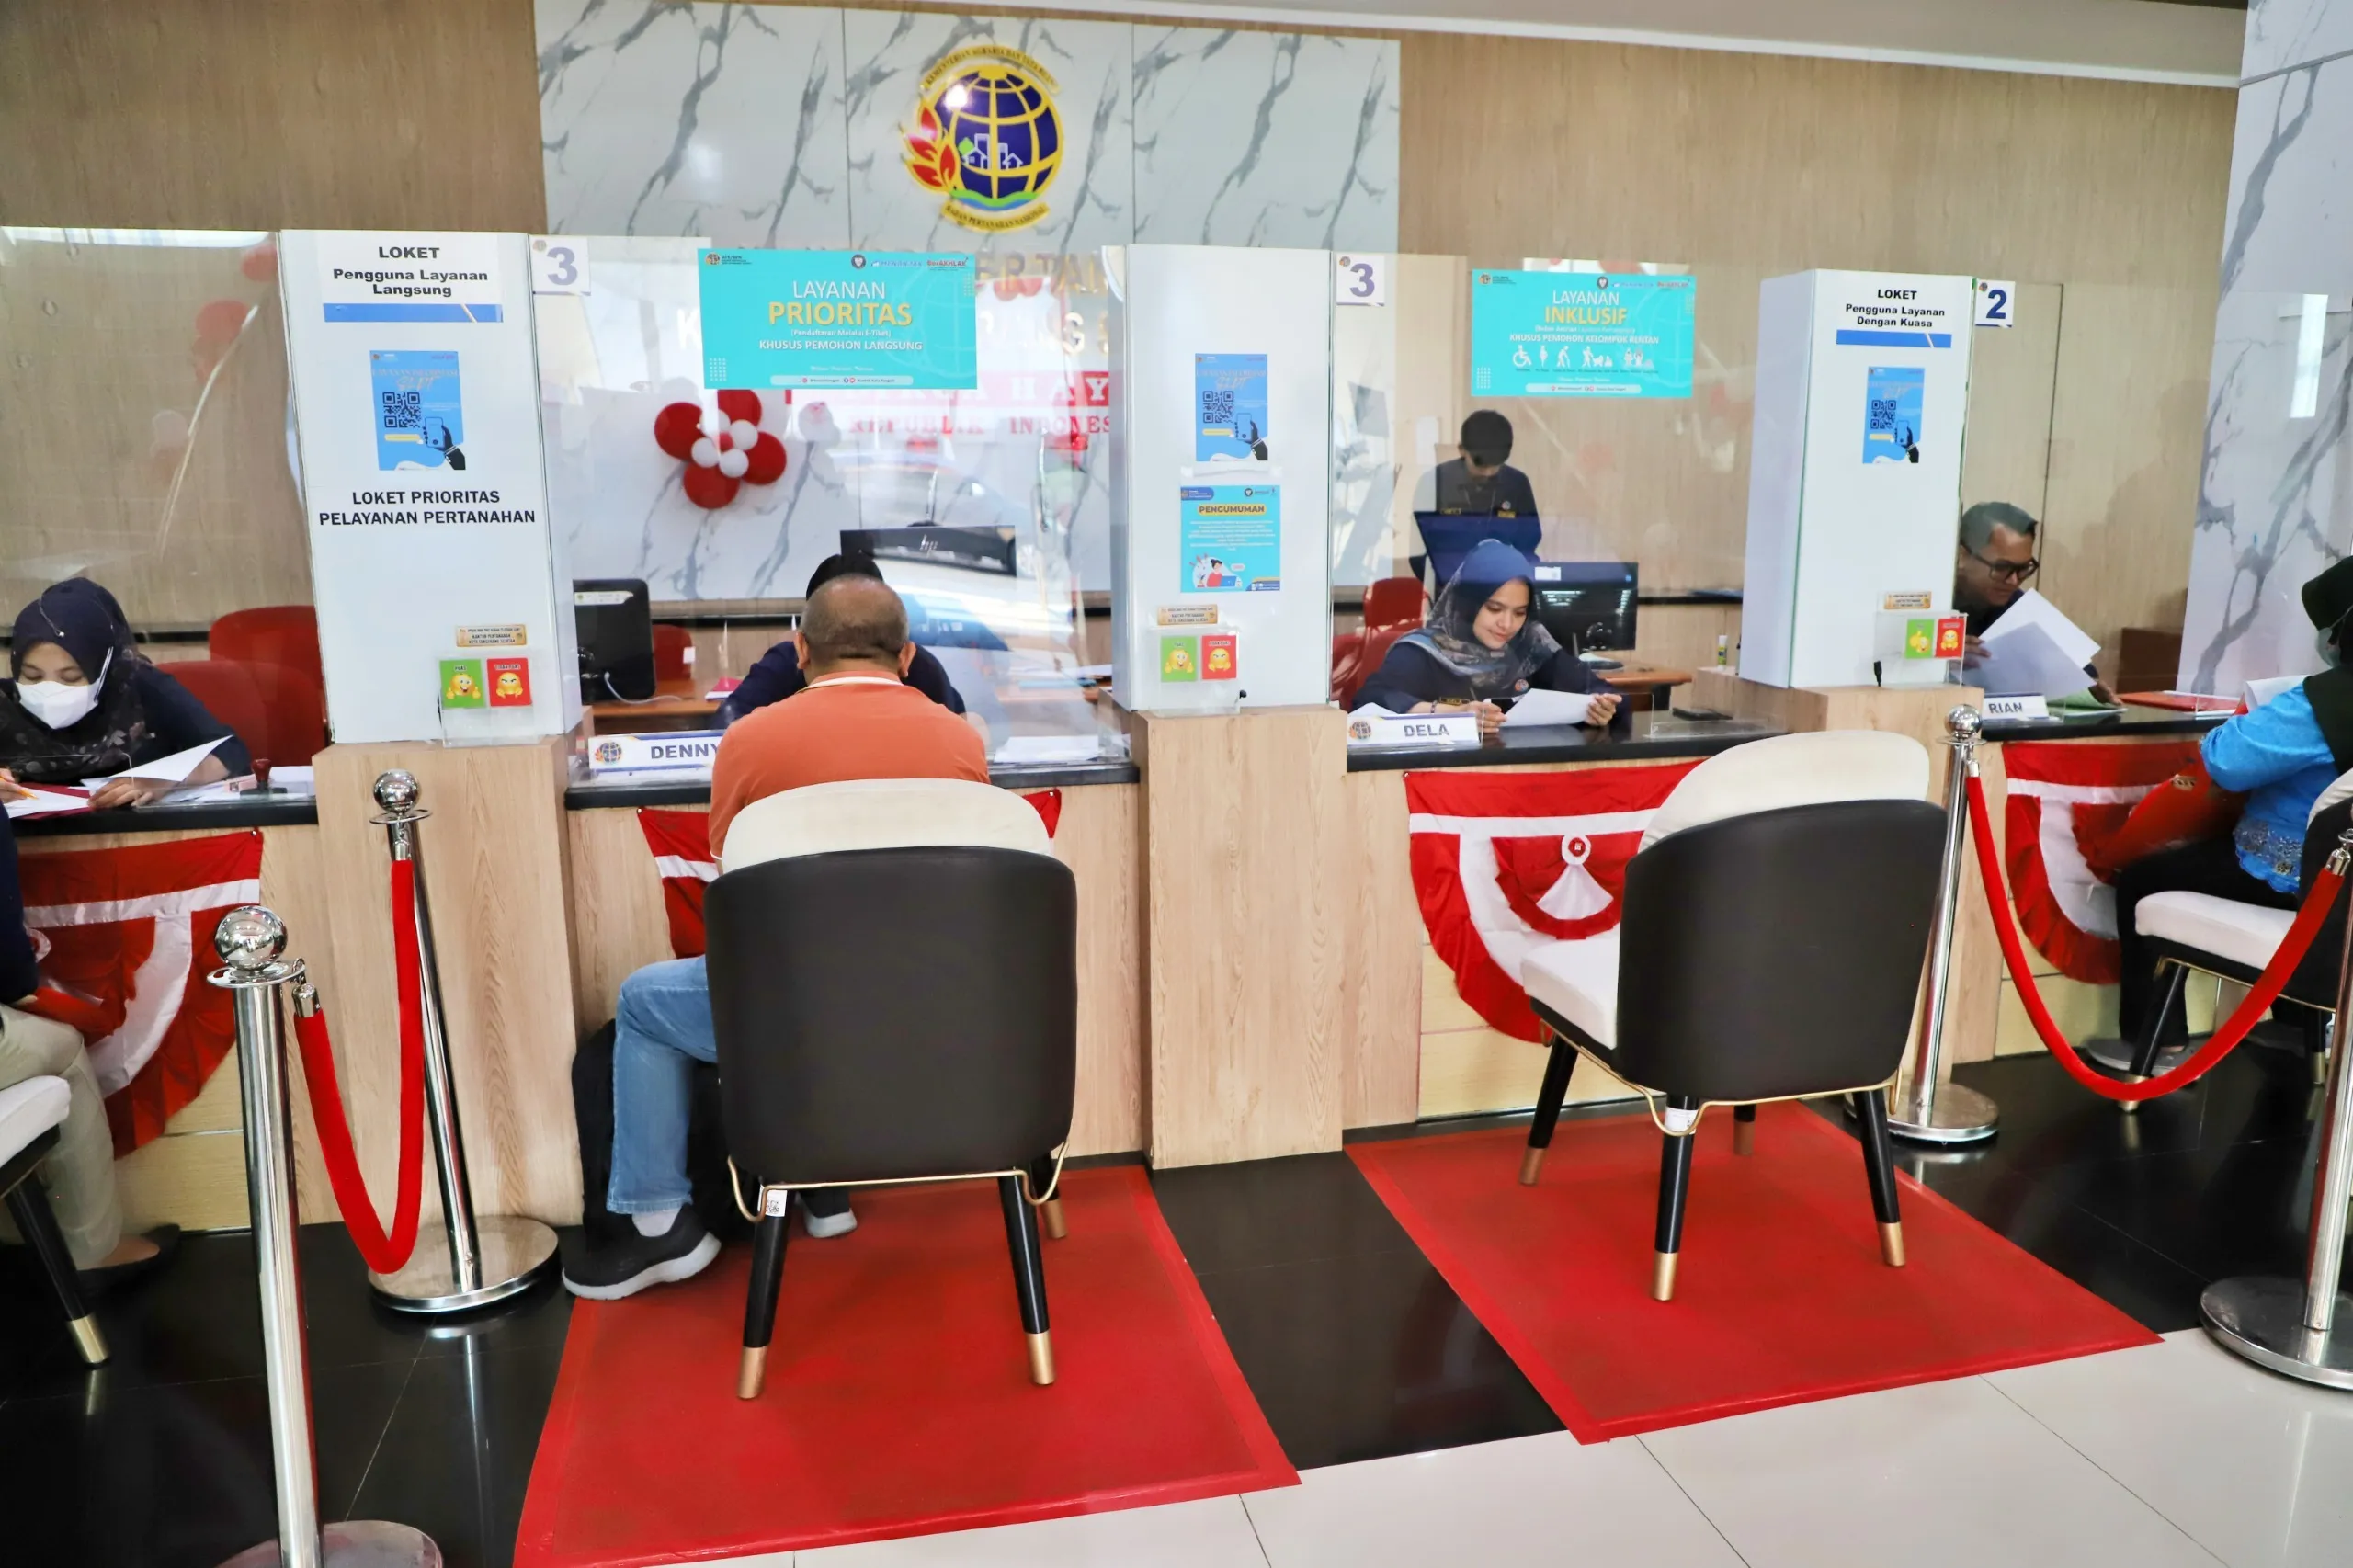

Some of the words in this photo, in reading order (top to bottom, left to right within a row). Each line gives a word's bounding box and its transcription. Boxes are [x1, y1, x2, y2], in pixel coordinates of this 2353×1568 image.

[379, 246, 440, 259] LOKET
[546, 246, 578, 286] 3
[333, 268, 415, 283] Pengguna
[419, 269, 488, 282] Layanan
[1349, 263, 1375, 298] 3
[372, 284, 452, 298] Langsung
[792, 280, 886, 300] LAYANAN
[1877, 289, 1918, 301] LOKET
[1552, 290, 1620, 306] LAYANAN
[1985, 289, 2008, 320] 2
[767, 301, 913, 327] PRIORITAS
[1545, 306, 1629, 325] INKLUSIF
[1846, 303, 1898, 316] Pengguna
[1901, 305, 1945, 317] Layanan
[1857, 316, 1896, 328] Dengan
[1900, 317, 1933, 328] Kuasa
[759, 340, 802, 351] KHUSUS
[805, 340, 860, 351] PEMOHON
[864, 341, 923, 351] LANGSUNG
[1510, 333, 1541, 342] KHUSUS
[1543, 334, 1584, 343] PEMOHON
[1586, 335, 1629, 344] KELOMPOK
[352, 492, 405, 506] LOKET
[411, 491, 501, 505] PRIORITAS
[1199, 506, 1266, 514] PENGUMUMAN
[319, 512, 418, 526] PELAYANAN
[424, 510, 536, 524] PERTANAHAN
[1988, 701, 2023, 714] RIAN
[1404, 723, 1450, 737] DELA
